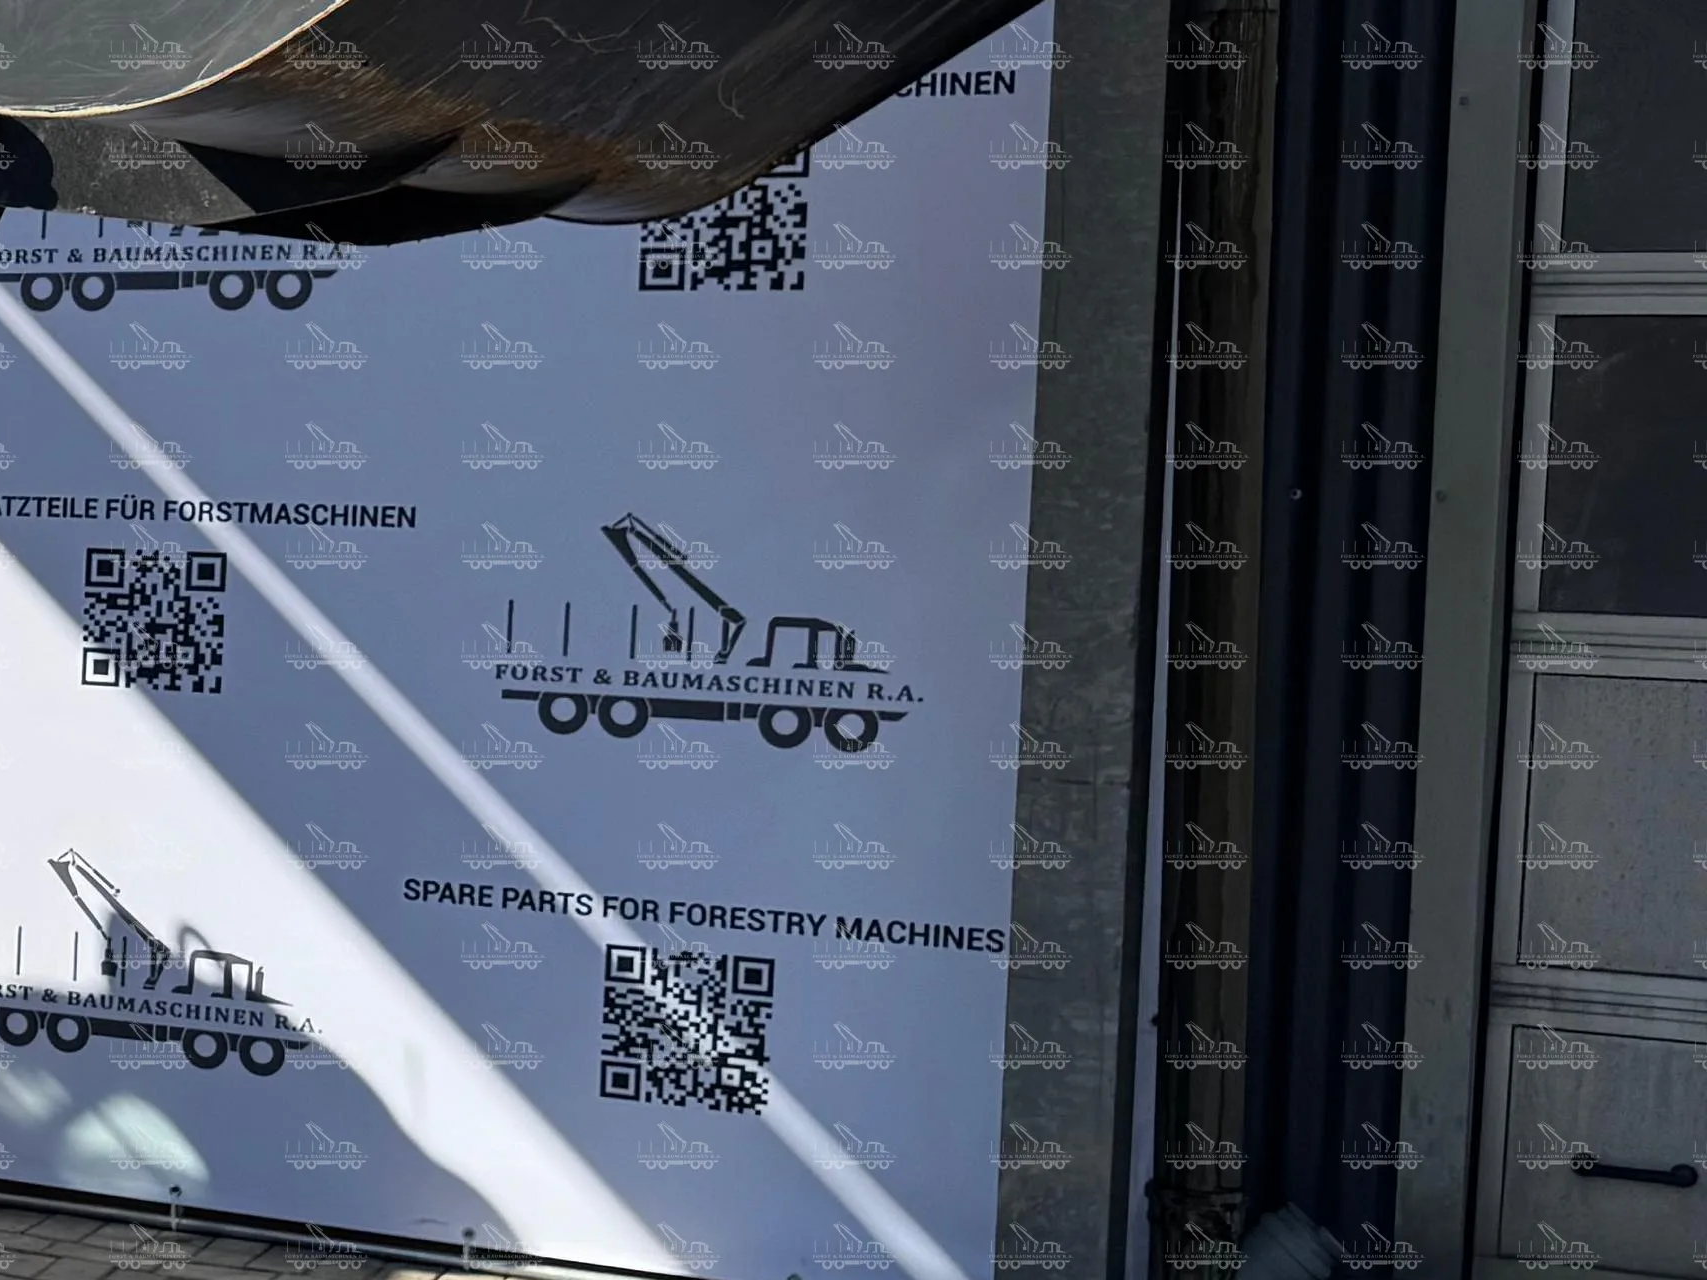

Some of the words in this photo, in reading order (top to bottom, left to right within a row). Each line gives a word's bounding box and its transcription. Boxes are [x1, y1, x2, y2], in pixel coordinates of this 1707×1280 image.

[93, 243, 294, 264] BAUMASCHINEN
[105, 492, 156, 522] FÜR
[163, 499, 417, 529] FORSTMASCHINEN
[494, 663, 583, 684] FORST
[592, 668, 613, 686] &
[622, 669, 855, 699] BAUMASCHINEN
[867, 682, 925, 703] R.A.
[402, 878, 494, 907] SPARE
[501, 886, 593, 916] PARTS
[602, 895, 660, 922] FOR
[669, 901, 827, 937] FORESTRY
[834, 915, 1007, 954] MACHINES
[41, 989, 58, 1004] &
[66, 991, 265, 1029] BAUMASCHINEN
[274, 1013, 323, 1035] R.A.
